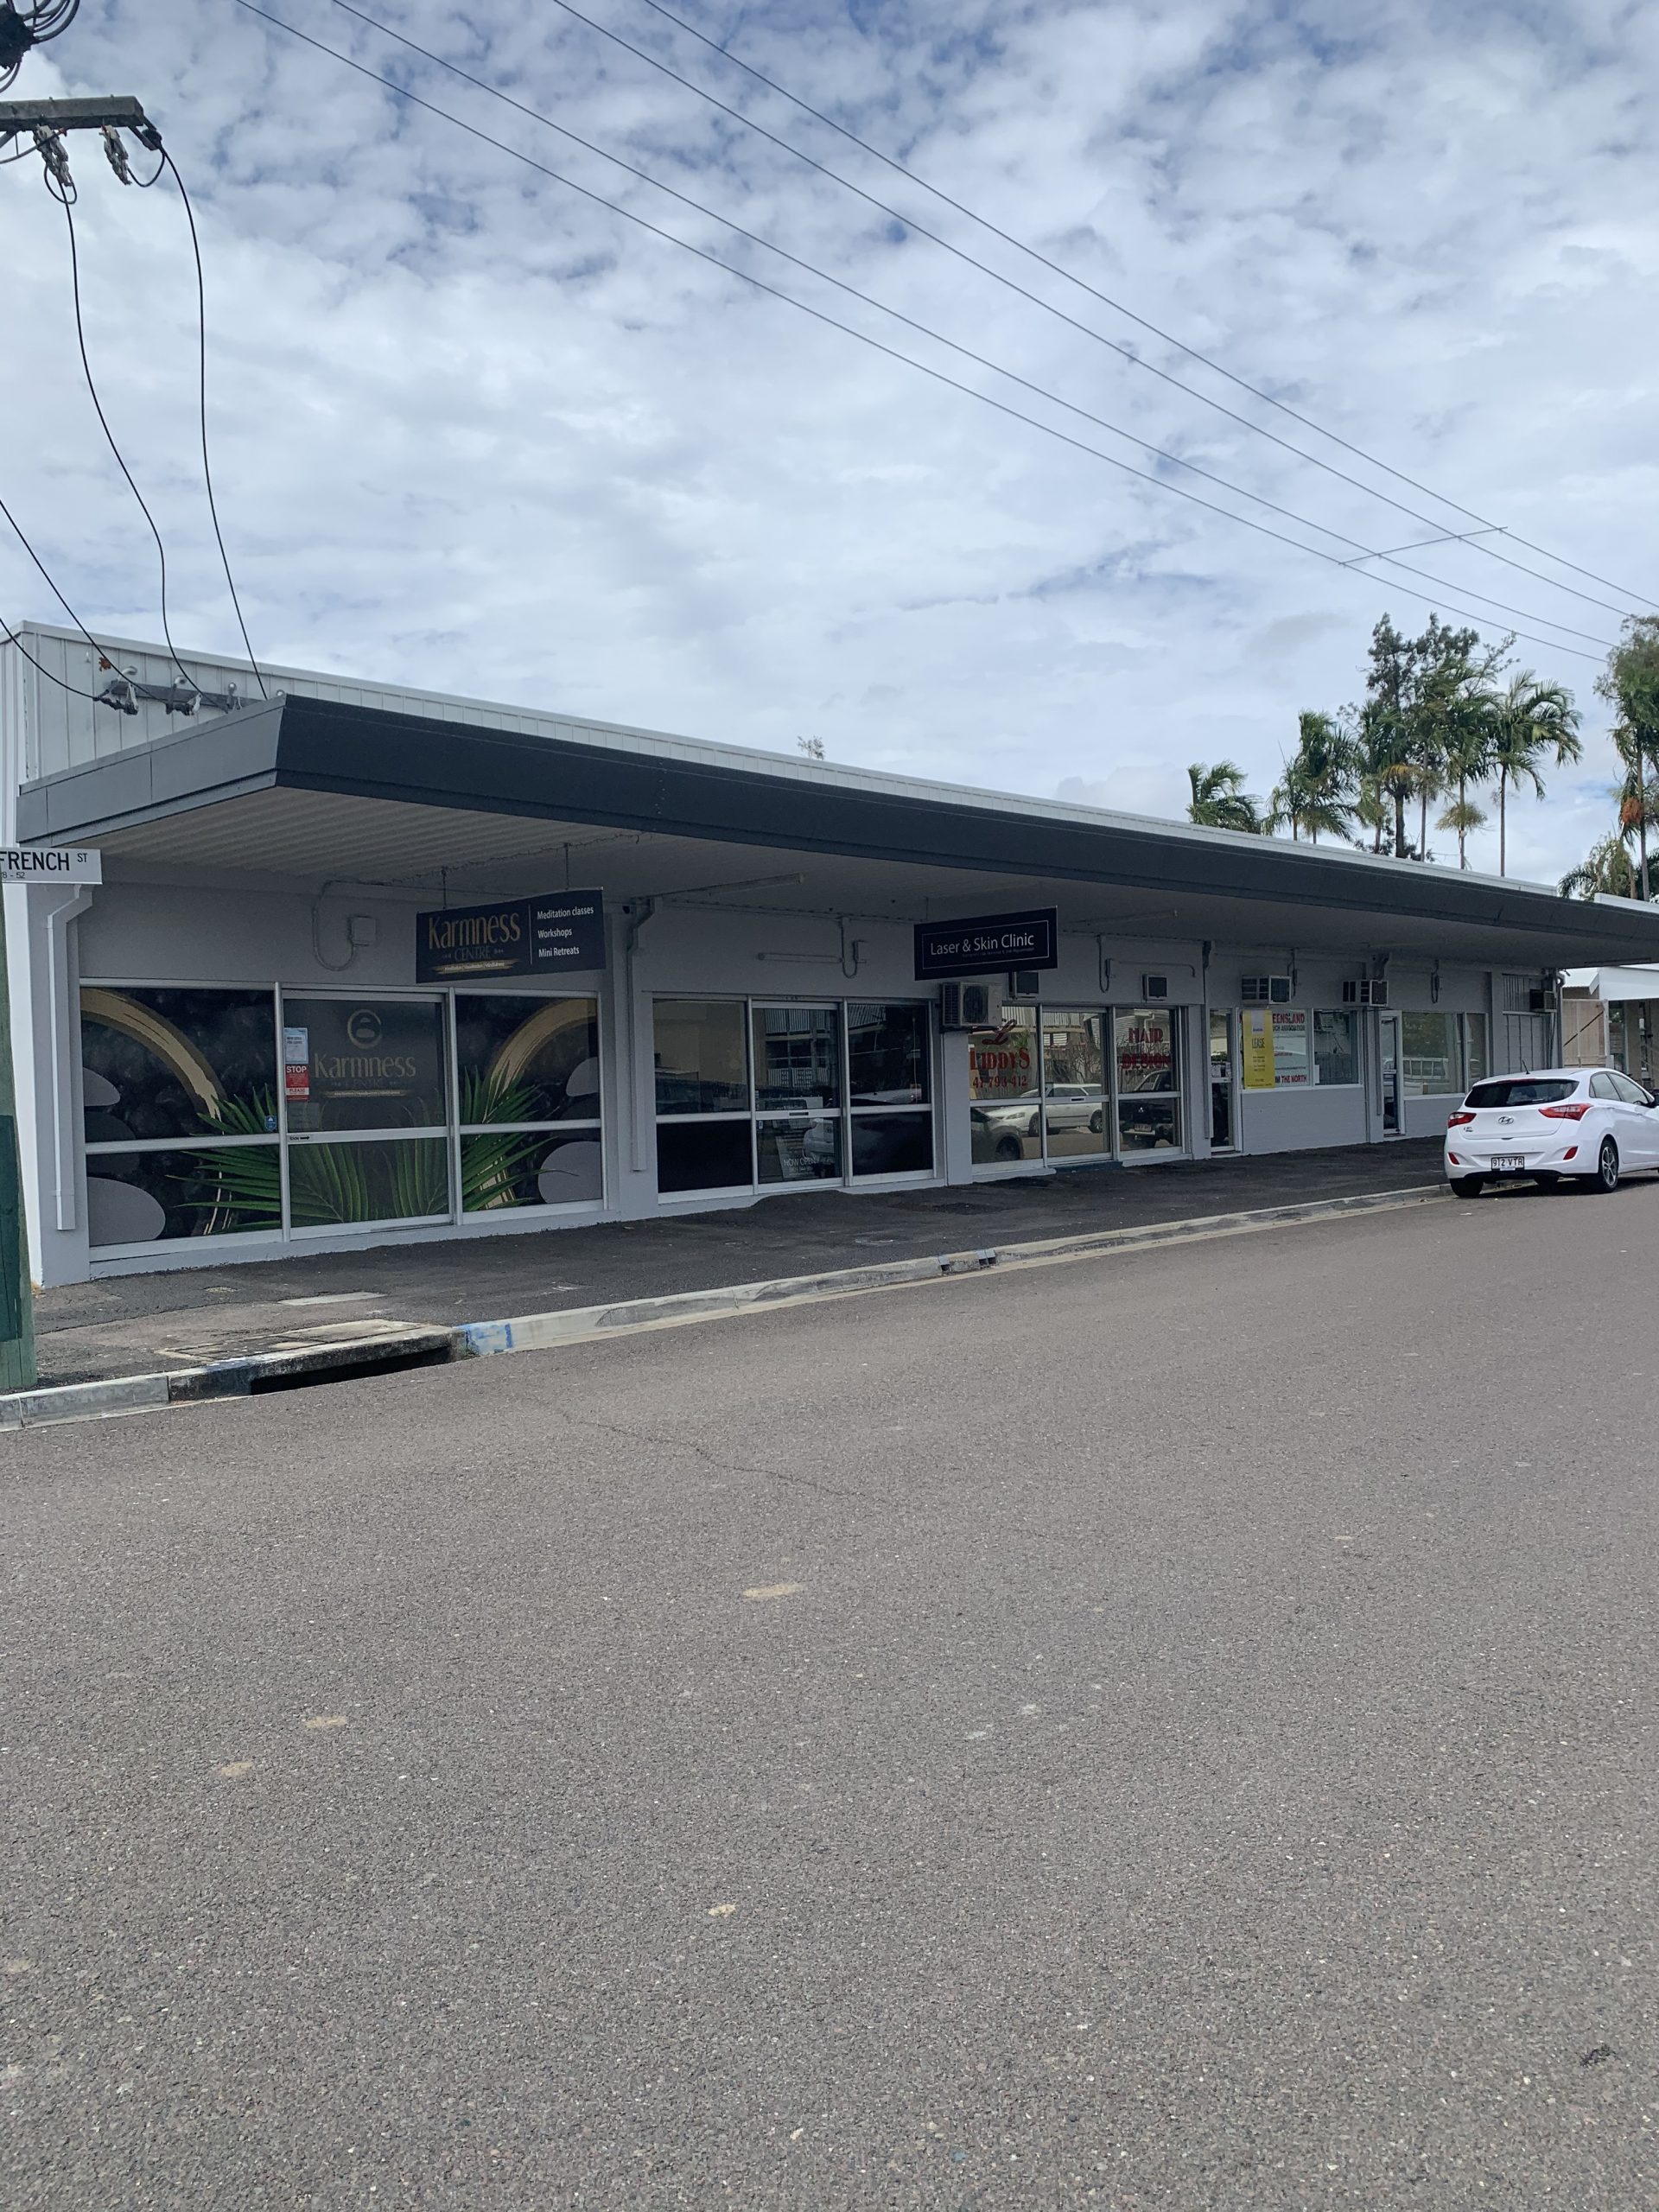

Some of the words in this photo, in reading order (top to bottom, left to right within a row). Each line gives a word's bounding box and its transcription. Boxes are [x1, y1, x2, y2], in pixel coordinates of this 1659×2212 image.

[77, 853, 88, 862] ST
[537, 908, 570, 920] Meditation
[571, 906, 594, 916] classes
[429, 912, 521, 950] Karmness
[537, 927, 572, 938] Workshops
[538, 947, 553, 957] Mini
[553, 945, 580, 957] Retreats
[931, 943, 960, 956] Laser
[963, 938, 971, 952] &
[974, 936, 998, 951] Skin
[1001, 932, 1034, 948] Clinic
[454, 945, 492, 962] CENTRE
[1272, 1013, 1305, 1024] EENSLAND
[1128, 1027, 1164, 1043] HAIR
[1251, 1037, 1265, 1048] LEASE
[314, 1052, 416, 1078] Karmness
